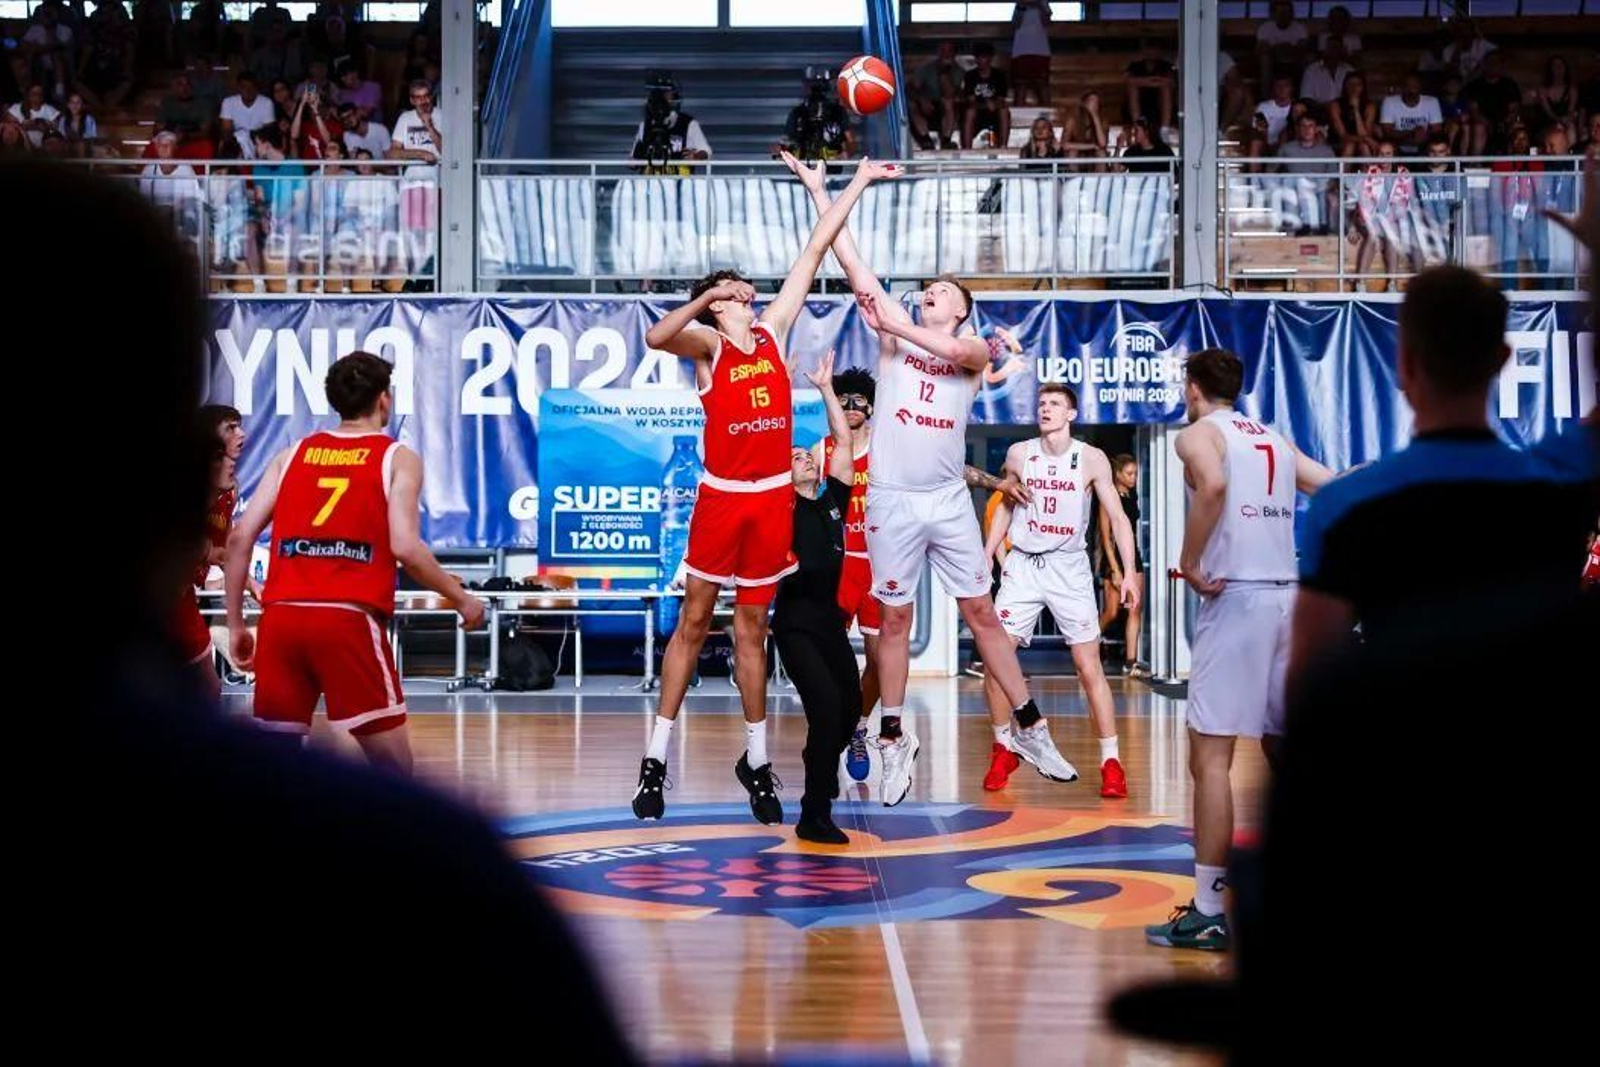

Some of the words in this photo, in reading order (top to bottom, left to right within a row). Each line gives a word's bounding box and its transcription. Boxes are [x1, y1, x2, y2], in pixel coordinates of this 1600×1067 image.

[1123, 335, 1156, 352] FIBA
[904, 354, 955, 376] POLSKA
[1036, 357, 1082, 384] U20
[1089, 358, 1187, 384] EUROBA
[749, 386, 771, 409] 15
[919, 380, 936, 403] 12
[1099, 388, 1145, 403] GDYNIA
[1147, 388, 1181, 403] 2024
[552, 405, 621, 416] OFICJALNA
[626, 406, 666, 416] WODA
[635, 419, 648, 428] W
[728, 416, 787, 435] endesa
[915, 415, 955, 430] ORLEN
[1254, 444, 1276, 496] 7
[1026, 478, 1076, 491] POLSKA
[312, 477, 350, 527] 7
[553, 485, 661, 511] SUPER
[850, 496, 867, 513] 11
[1043, 496, 1057, 514] 13
[1040, 524, 1075, 536] ORLEN
[569, 532, 625, 550] 1200
[628, 535, 651, 550] m
[295, 539, 368, 563] CaixaBank
